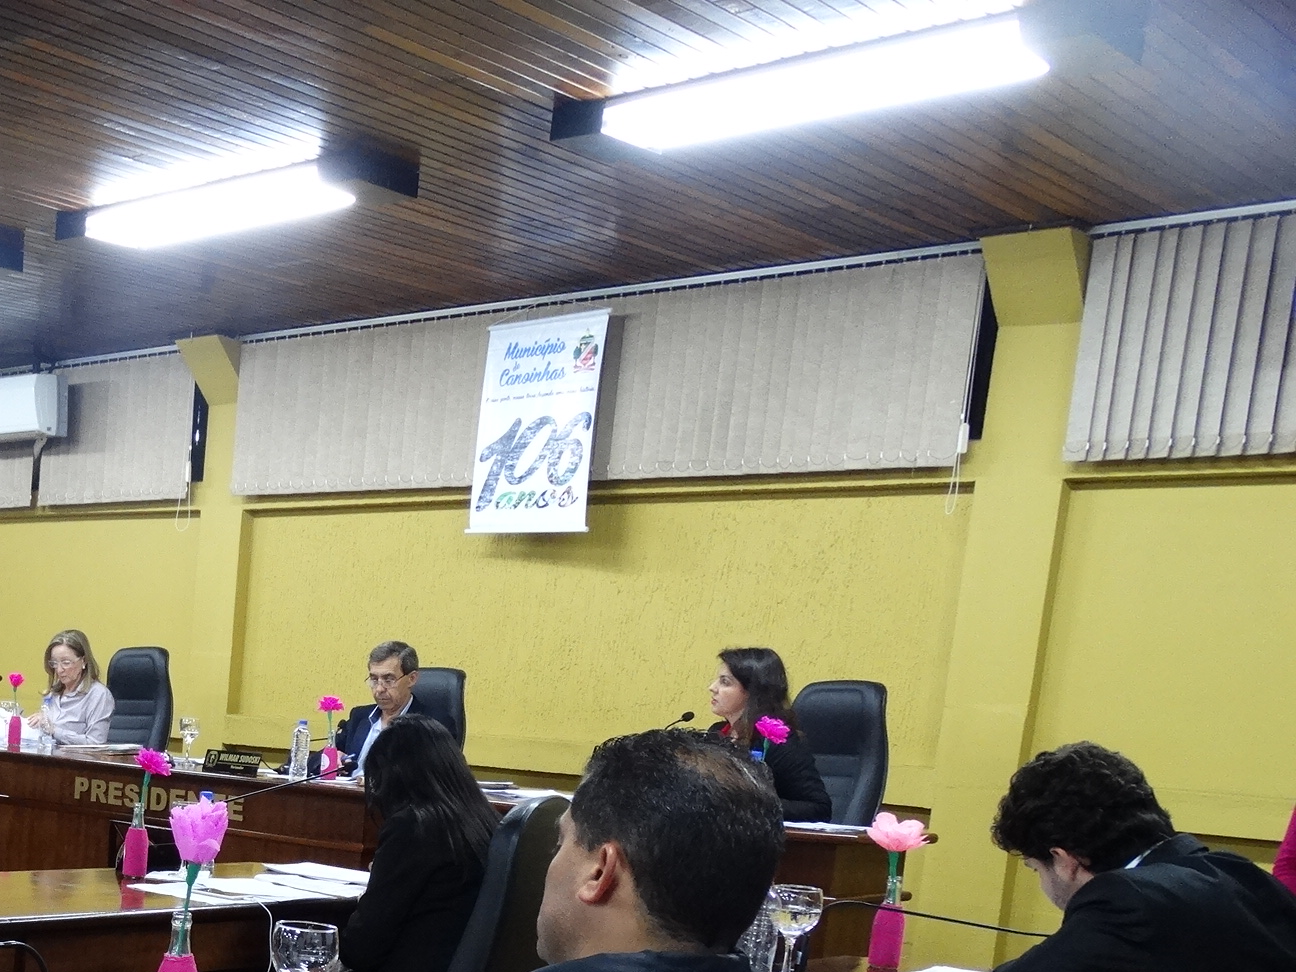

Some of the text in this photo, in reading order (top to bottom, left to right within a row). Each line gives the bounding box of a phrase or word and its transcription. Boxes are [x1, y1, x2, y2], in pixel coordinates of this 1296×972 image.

[504, 338, 566, 360] Município
[500, 361, 566, 387] Canoinhas
[476, 412, 592, 512] 106
[219, 754, 239, 762] WILMAR
